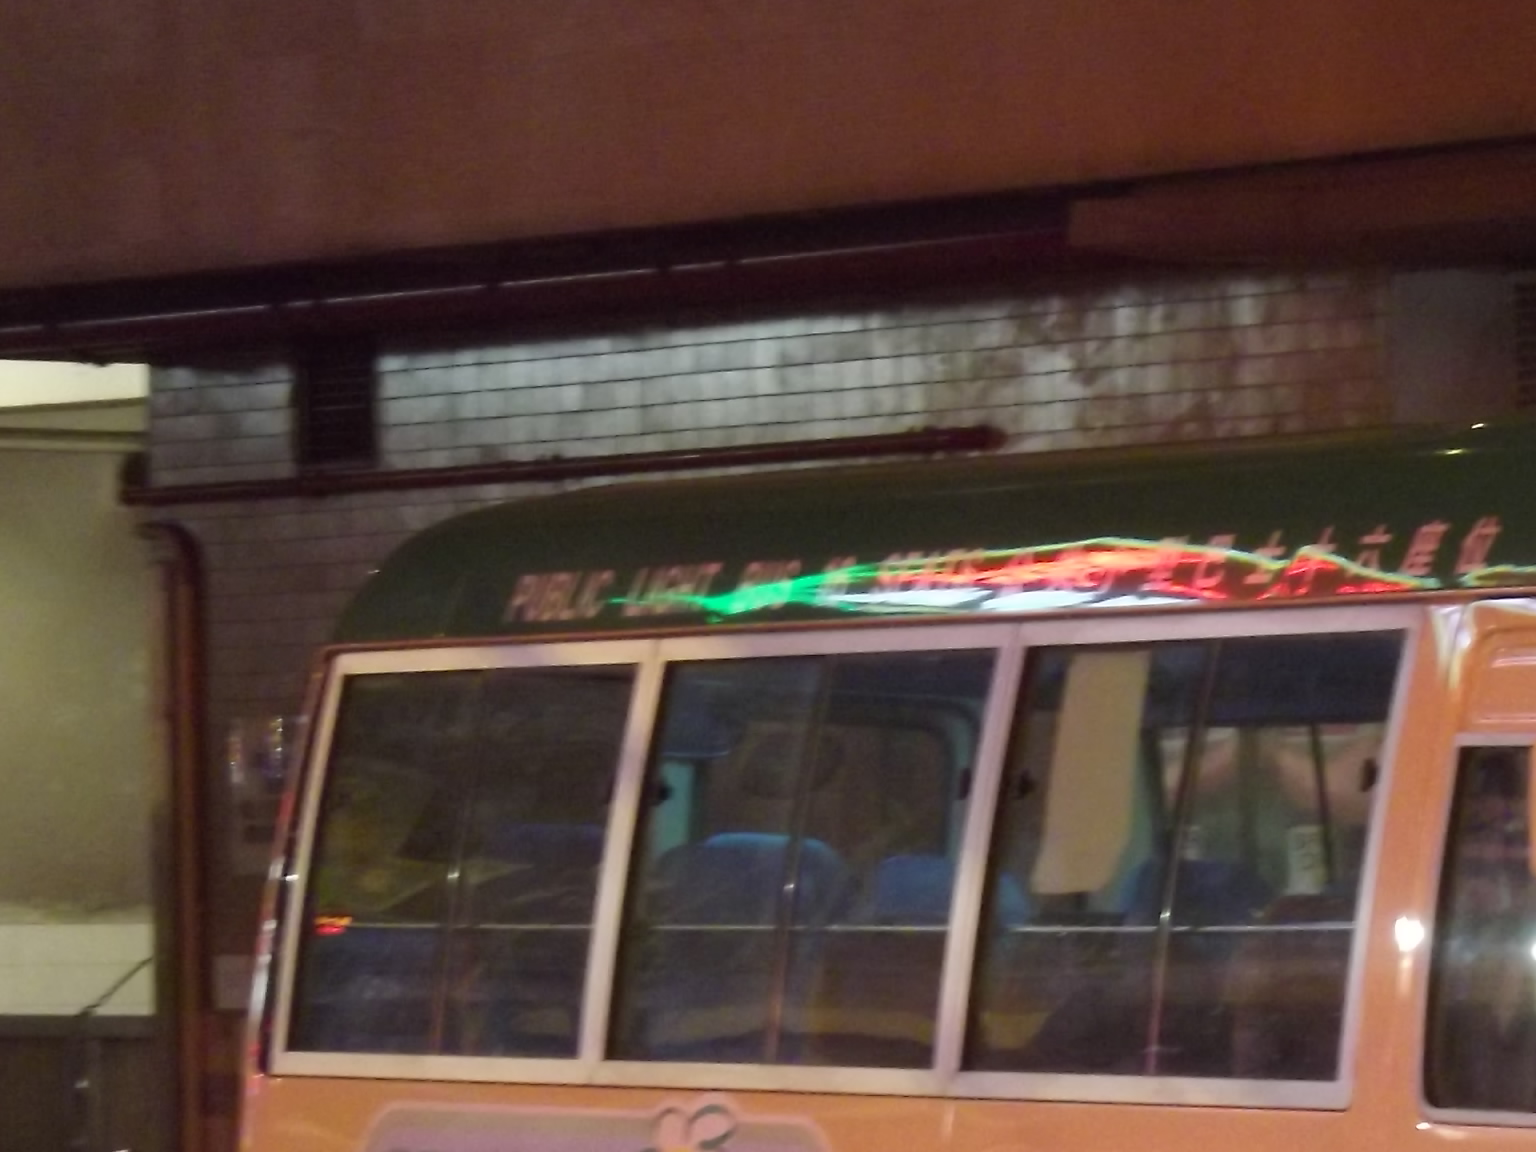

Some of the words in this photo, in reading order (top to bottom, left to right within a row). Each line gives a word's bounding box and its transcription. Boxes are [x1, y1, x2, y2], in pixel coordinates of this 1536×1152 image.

[505, 569, 616, 622] PUBLIC
[625, 561, 725, 618] LIGHT
[729, 557, 803, 612] BUS
